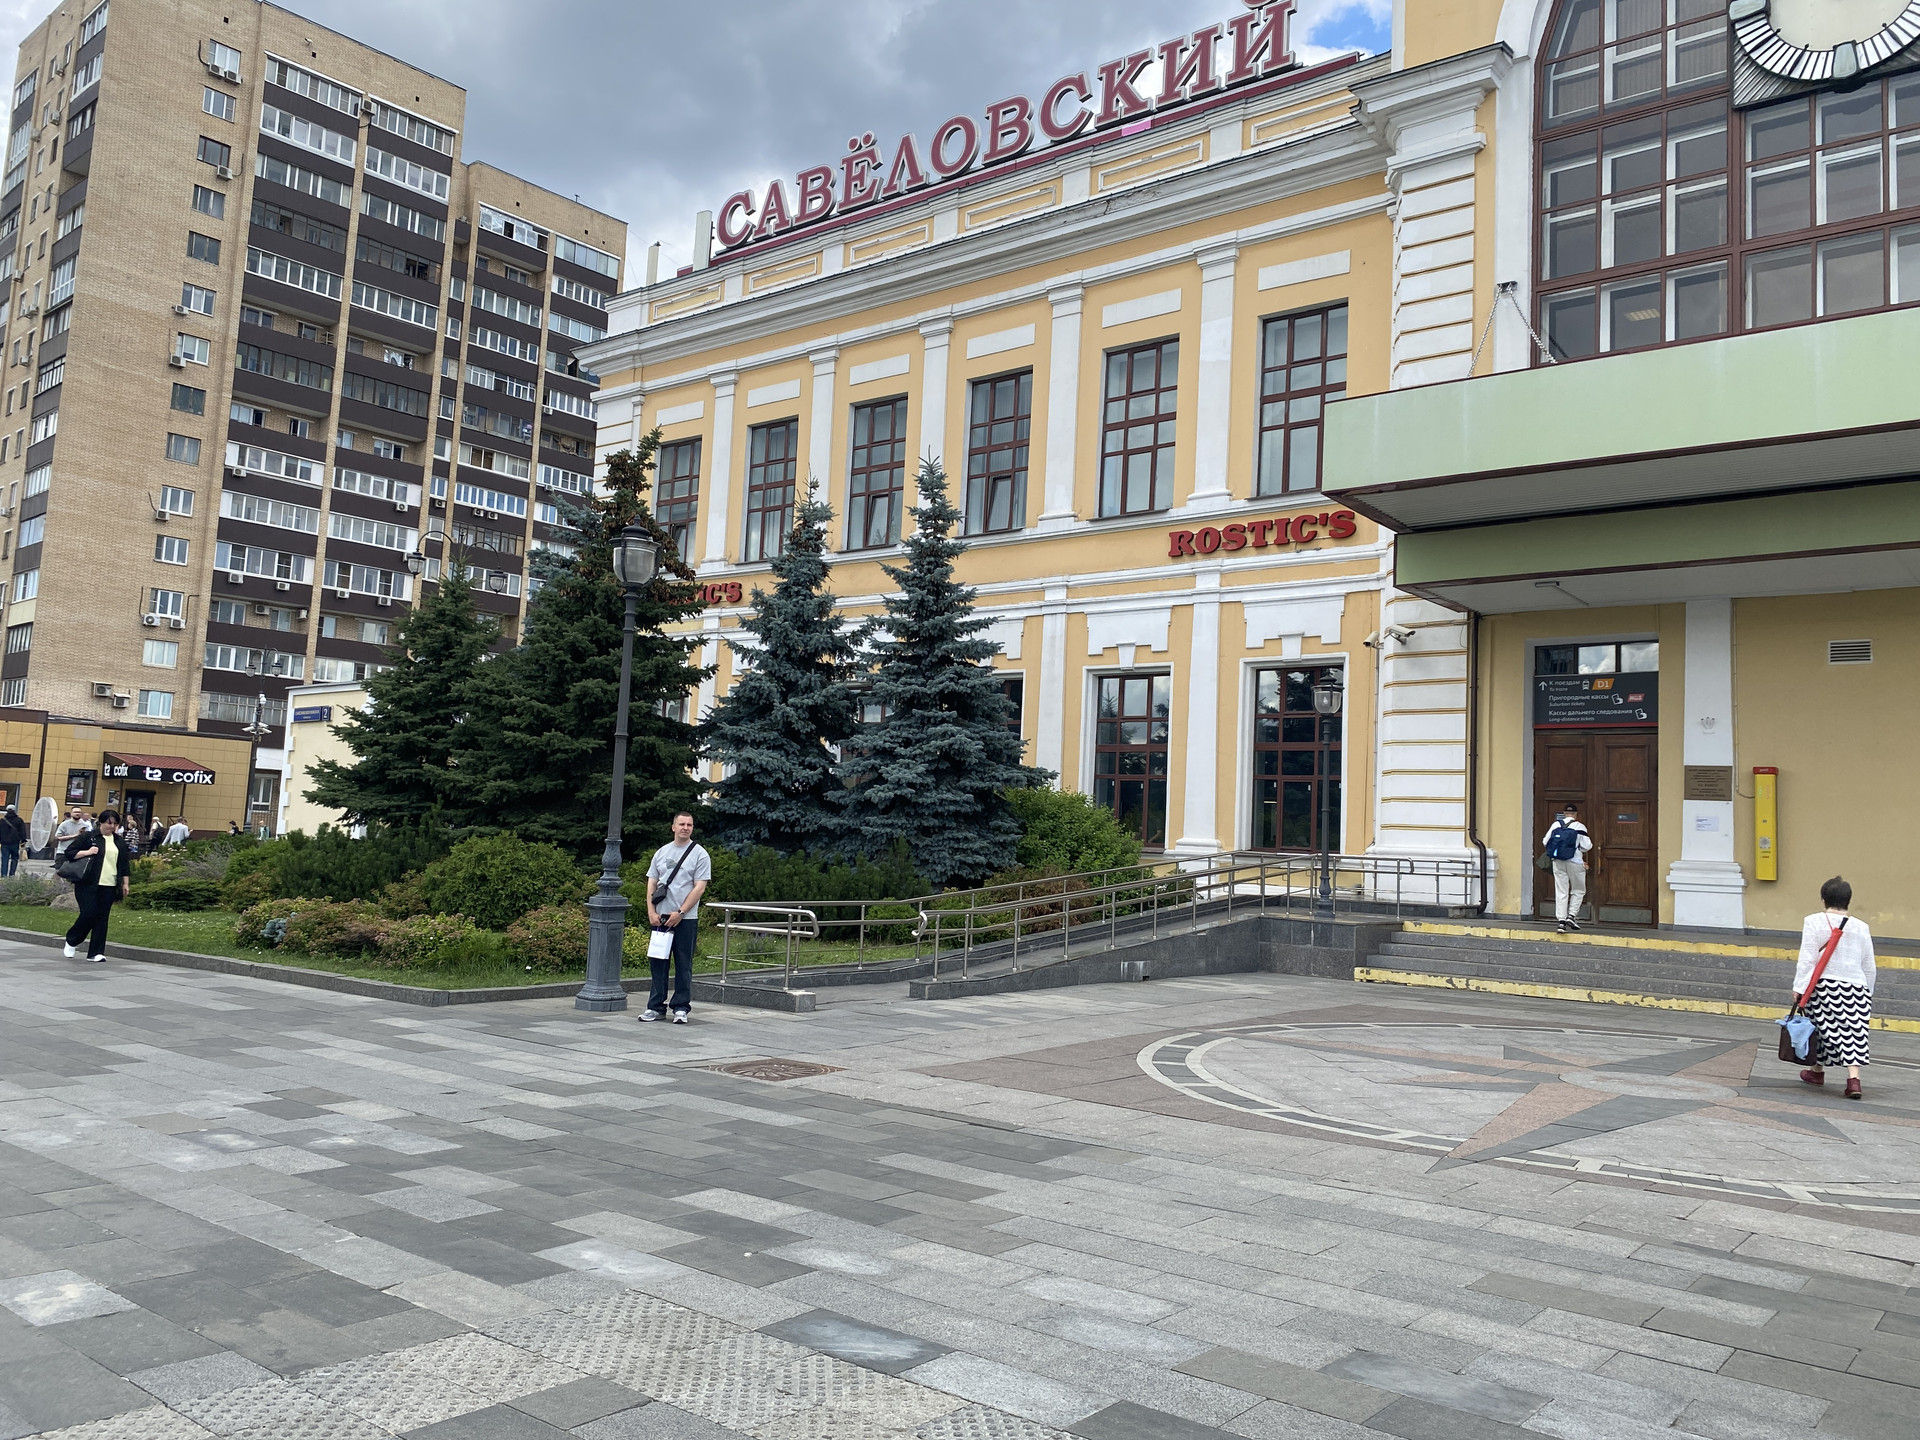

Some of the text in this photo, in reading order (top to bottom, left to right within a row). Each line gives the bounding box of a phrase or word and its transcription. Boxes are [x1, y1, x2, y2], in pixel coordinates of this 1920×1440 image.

[717, 0, 1298, 248] САВЁЛОВСКИЙ
[1168, 510, 1356, 557] ROSTIC'S
[1597, 680, 1609, 688] D1
[323, 708, 328, 719] 2
[113, 763, 128, 776] cofix
[145, 767, 213, 784] t2 cofix
